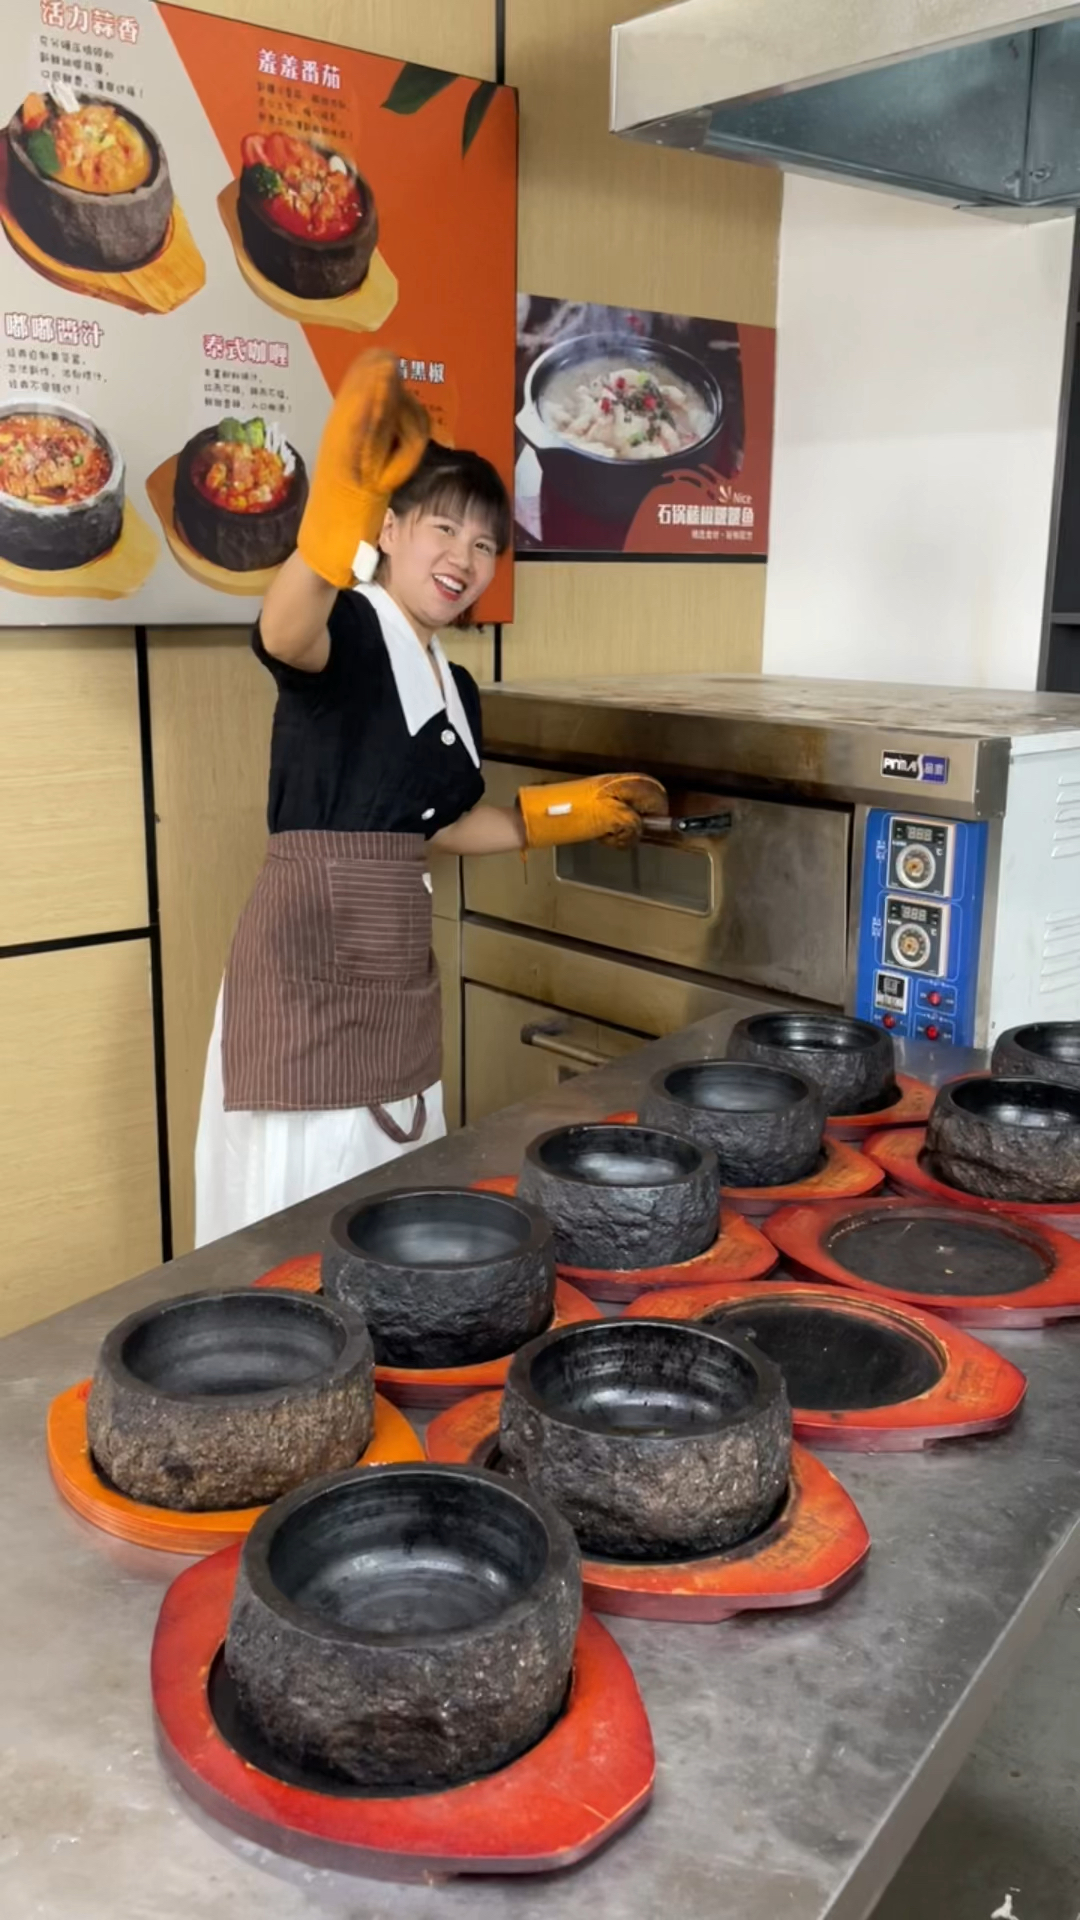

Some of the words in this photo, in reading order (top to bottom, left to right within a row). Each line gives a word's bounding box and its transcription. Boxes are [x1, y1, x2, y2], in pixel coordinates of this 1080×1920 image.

[40, 0, 140, 44] 活力蒜香
[258, 48, 340, 89] 羞羞番茄
[733, 491, 753, 504] Nice
